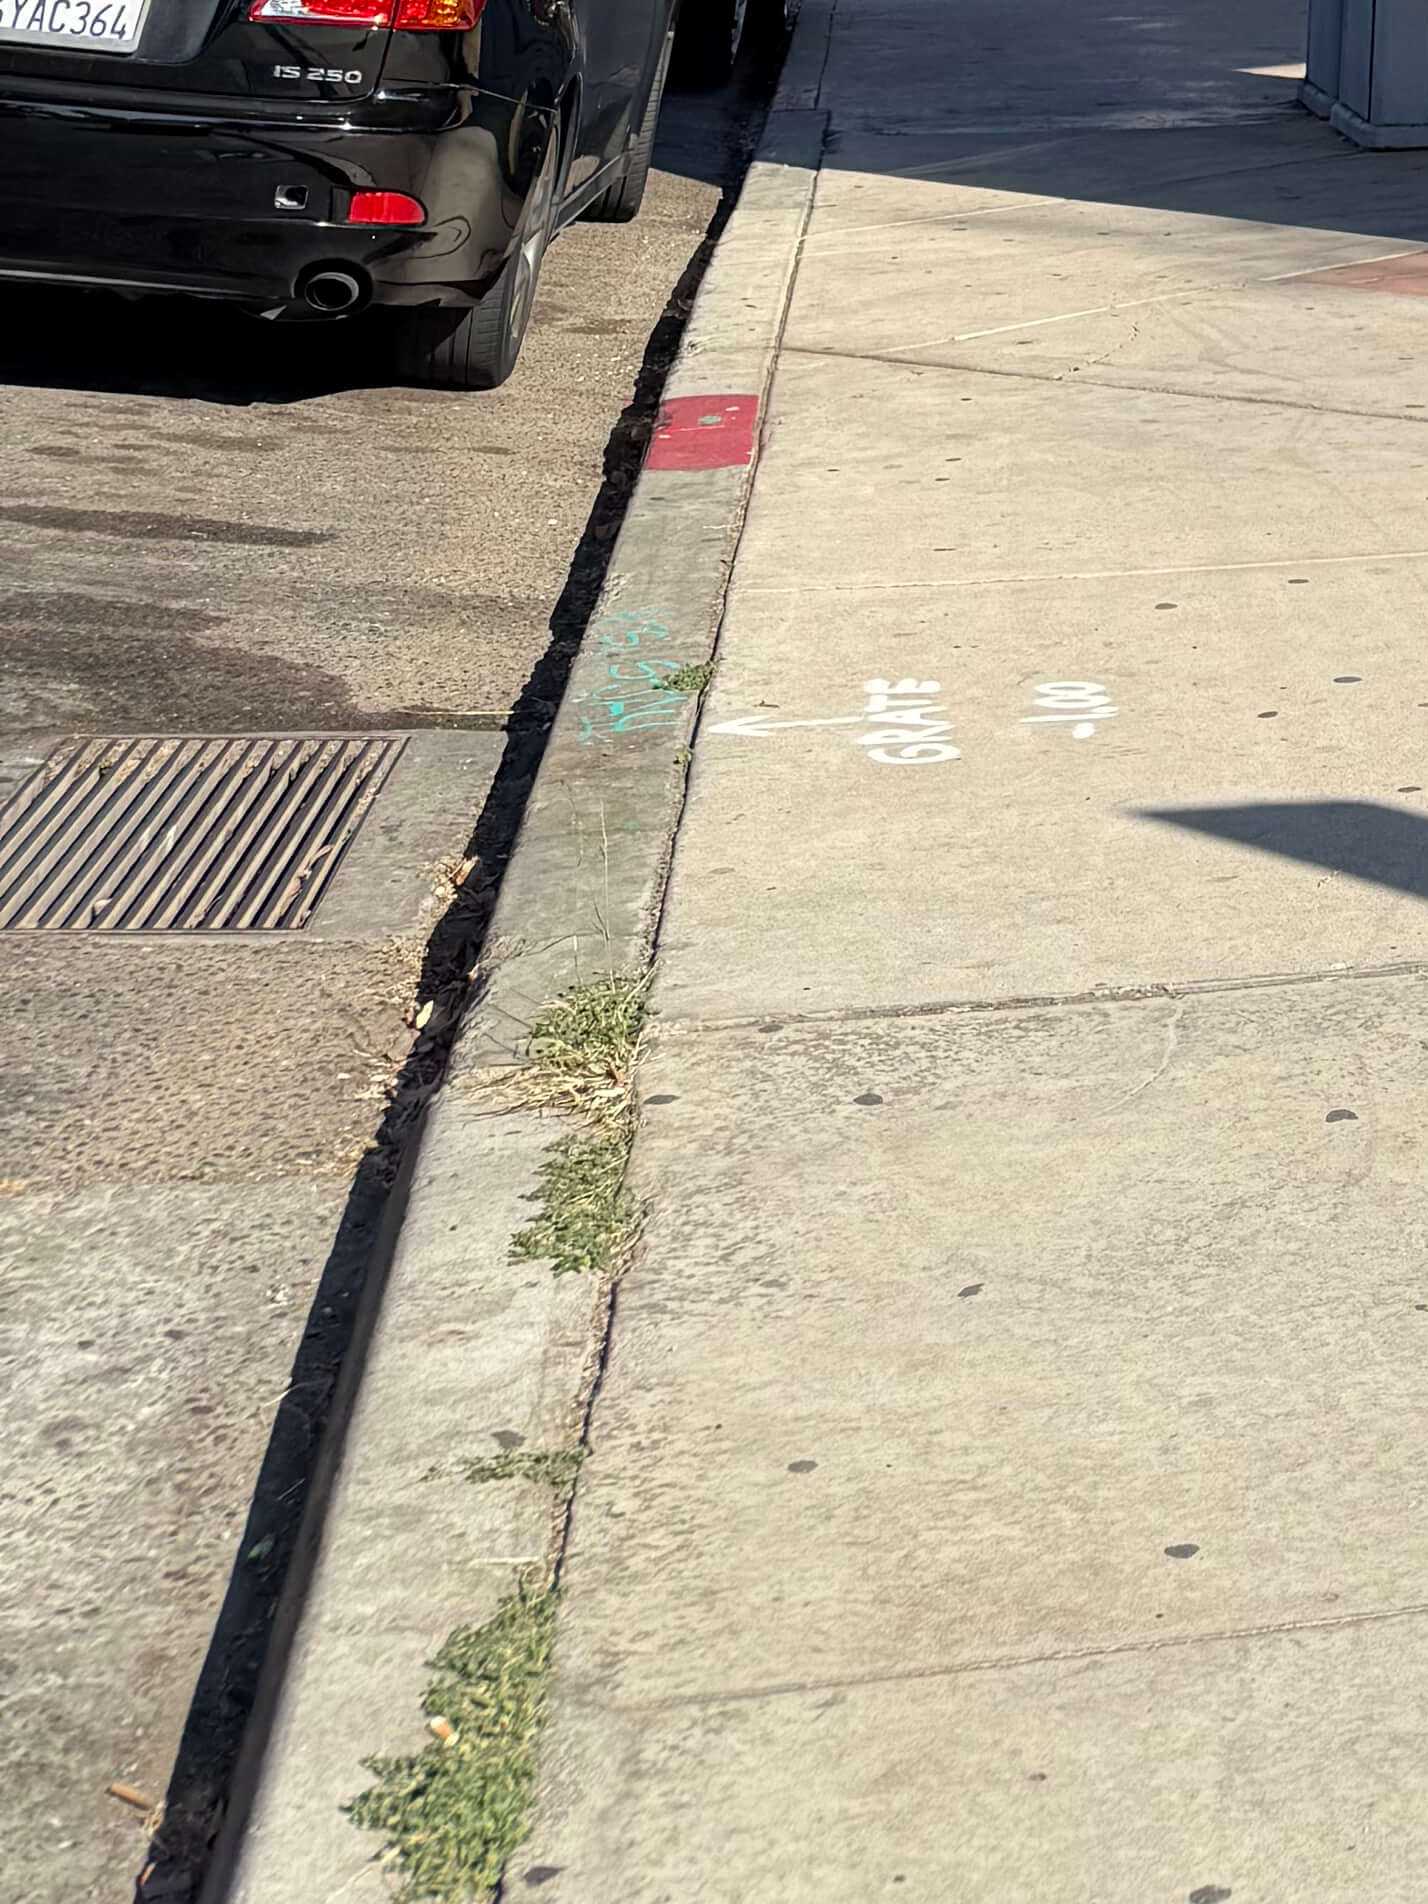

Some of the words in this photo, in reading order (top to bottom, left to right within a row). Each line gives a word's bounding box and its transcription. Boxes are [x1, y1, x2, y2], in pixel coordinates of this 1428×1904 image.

[273, 65, 301, 79] IS
[306, 67, 362, 84] 250
[856, 678, 961, 765] GRATE
